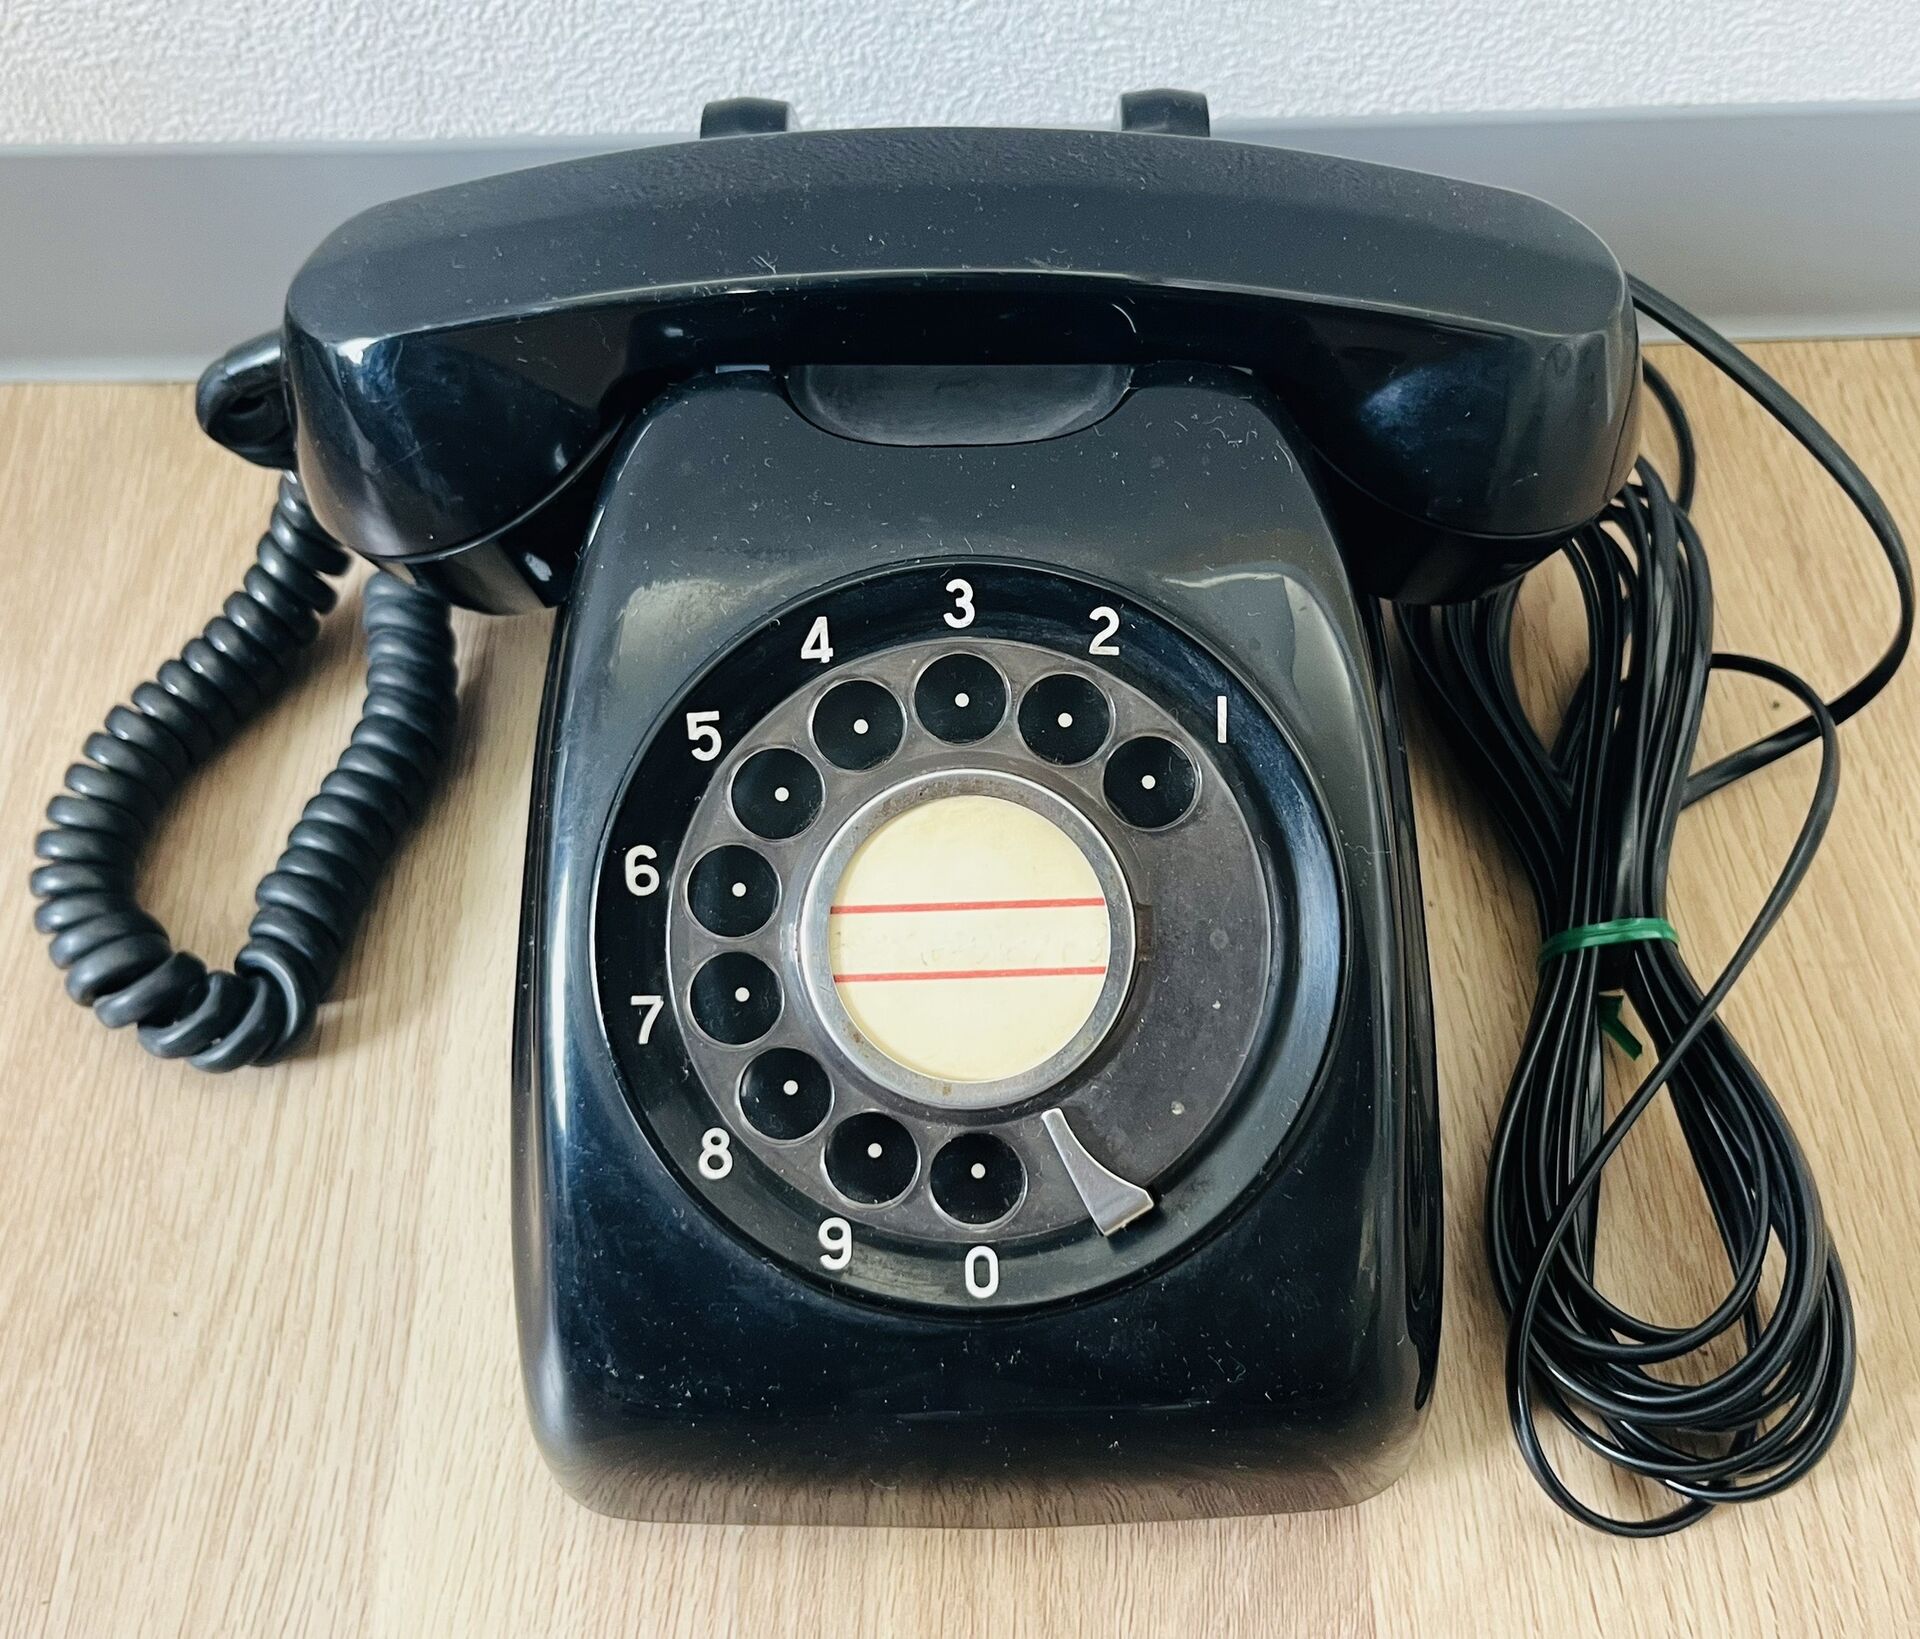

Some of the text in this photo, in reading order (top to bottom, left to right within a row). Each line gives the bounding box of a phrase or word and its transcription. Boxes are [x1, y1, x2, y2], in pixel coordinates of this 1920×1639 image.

[944, 579, 976, 629] 3
[801, 616, 834, 664] 4
[1089, 607, 1120, 656] 2
[687, 711, 722, 762] 5
[1217, 695, 1228, 744] 1
[625, 845, 660, 897] 6
[631, 996, 665, 1045] 7
[698, 1128, 733, 1181] 8
[818, 1217, 852, 1271] 9
[965, 1246, 999, 1300] 0
